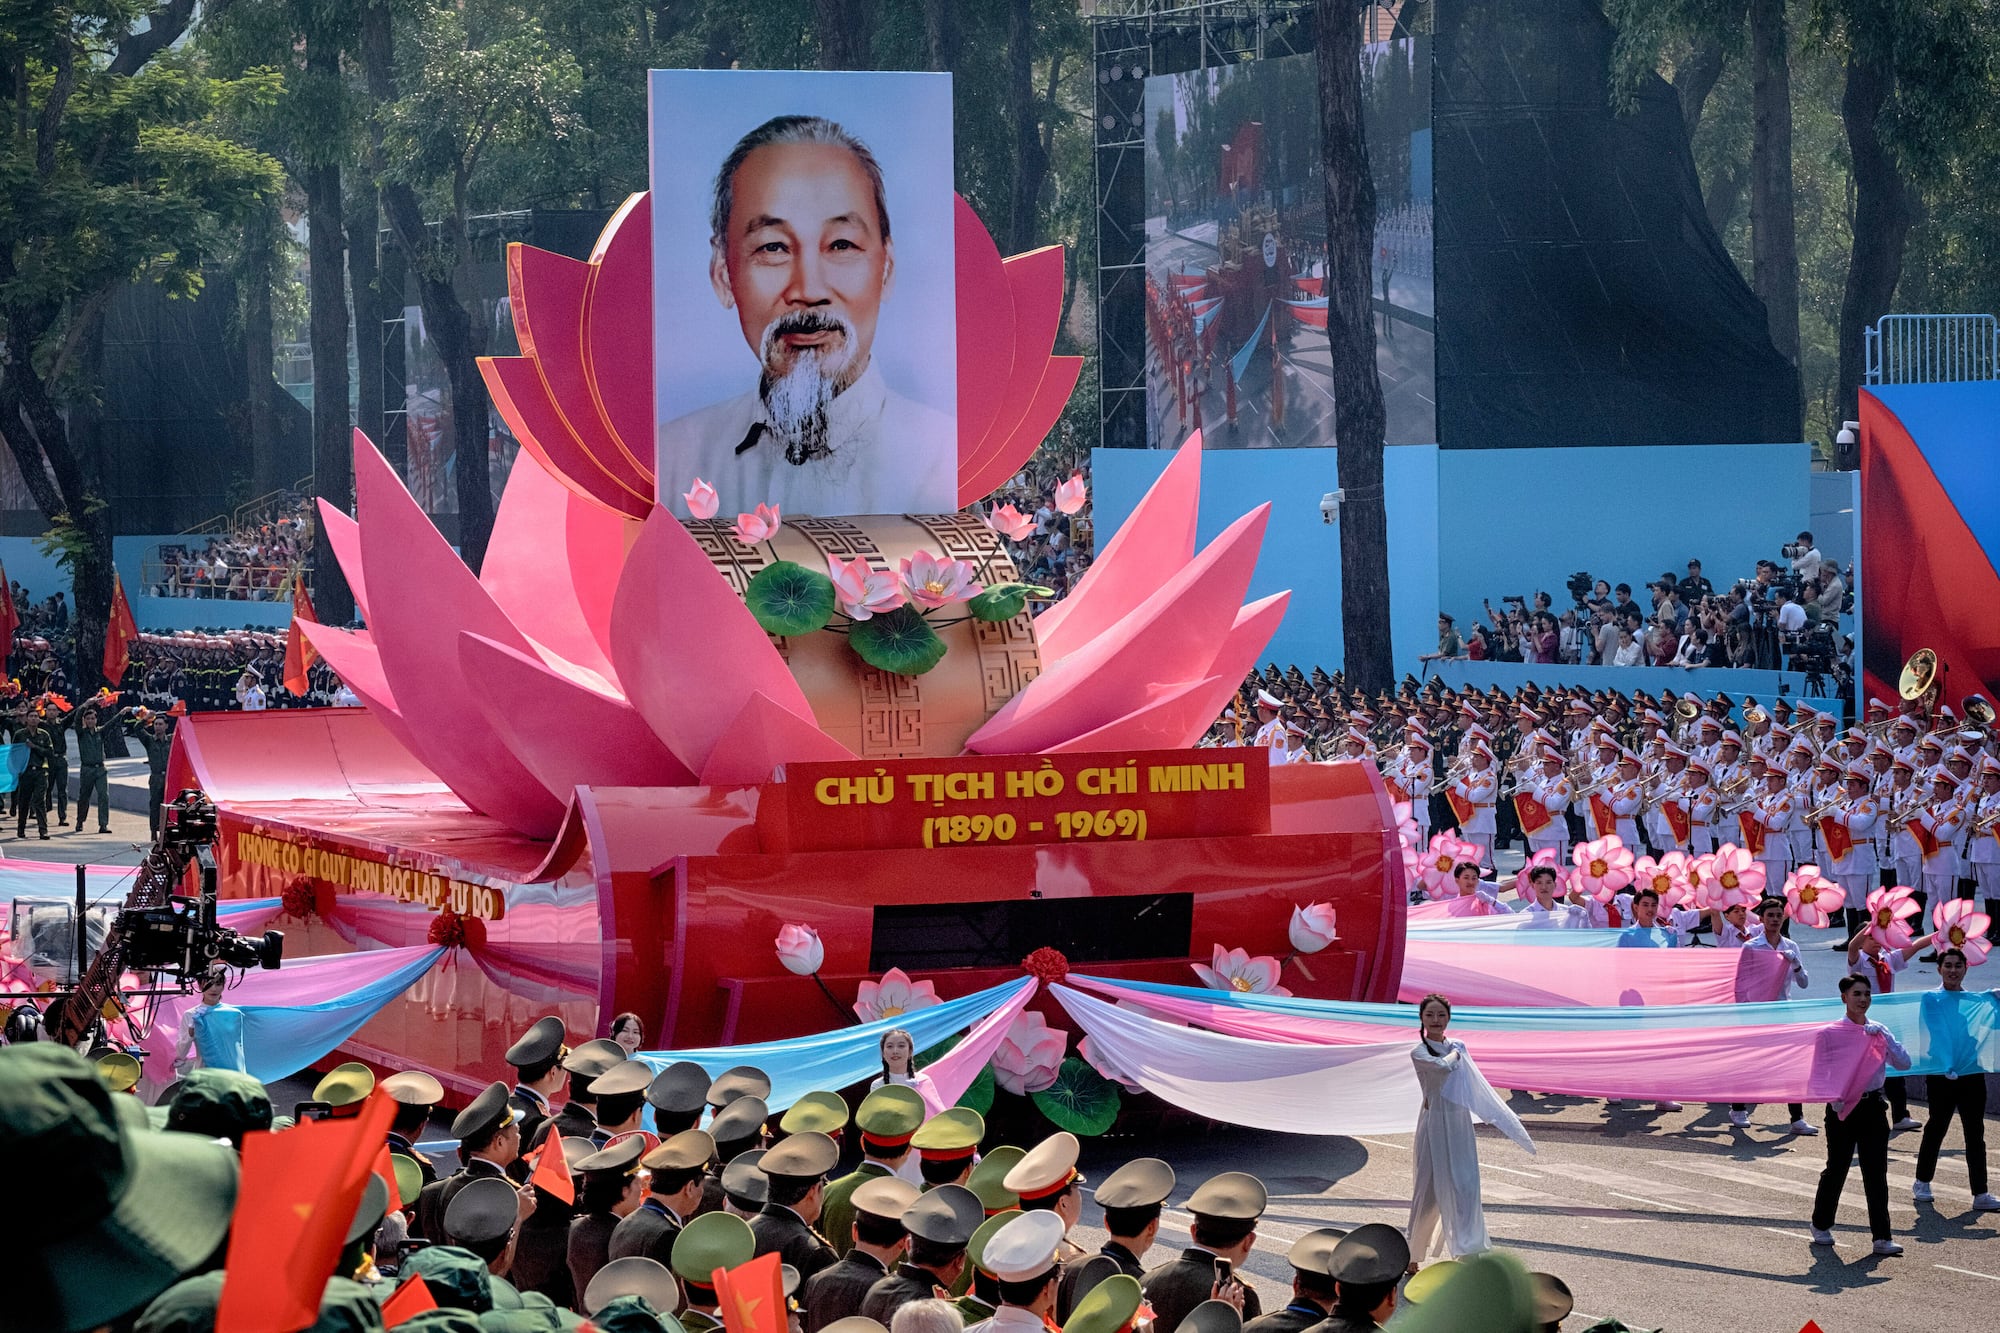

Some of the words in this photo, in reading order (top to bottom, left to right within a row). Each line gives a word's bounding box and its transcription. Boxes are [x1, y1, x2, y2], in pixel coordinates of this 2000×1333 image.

[815, 768, 894, 805] CHỦ
[906, 772, 995, 807] TỊCH
[1005, 758, 1065, 797] HỒ
[1076, 759, 1138, 795] CHÍ
[1149, 763, 1245, 792] MINH
[923, 813, 1017, 848] (1890
[1055, 809, 1147, 841] 1969)
[473, 886, 494, 921] DO
